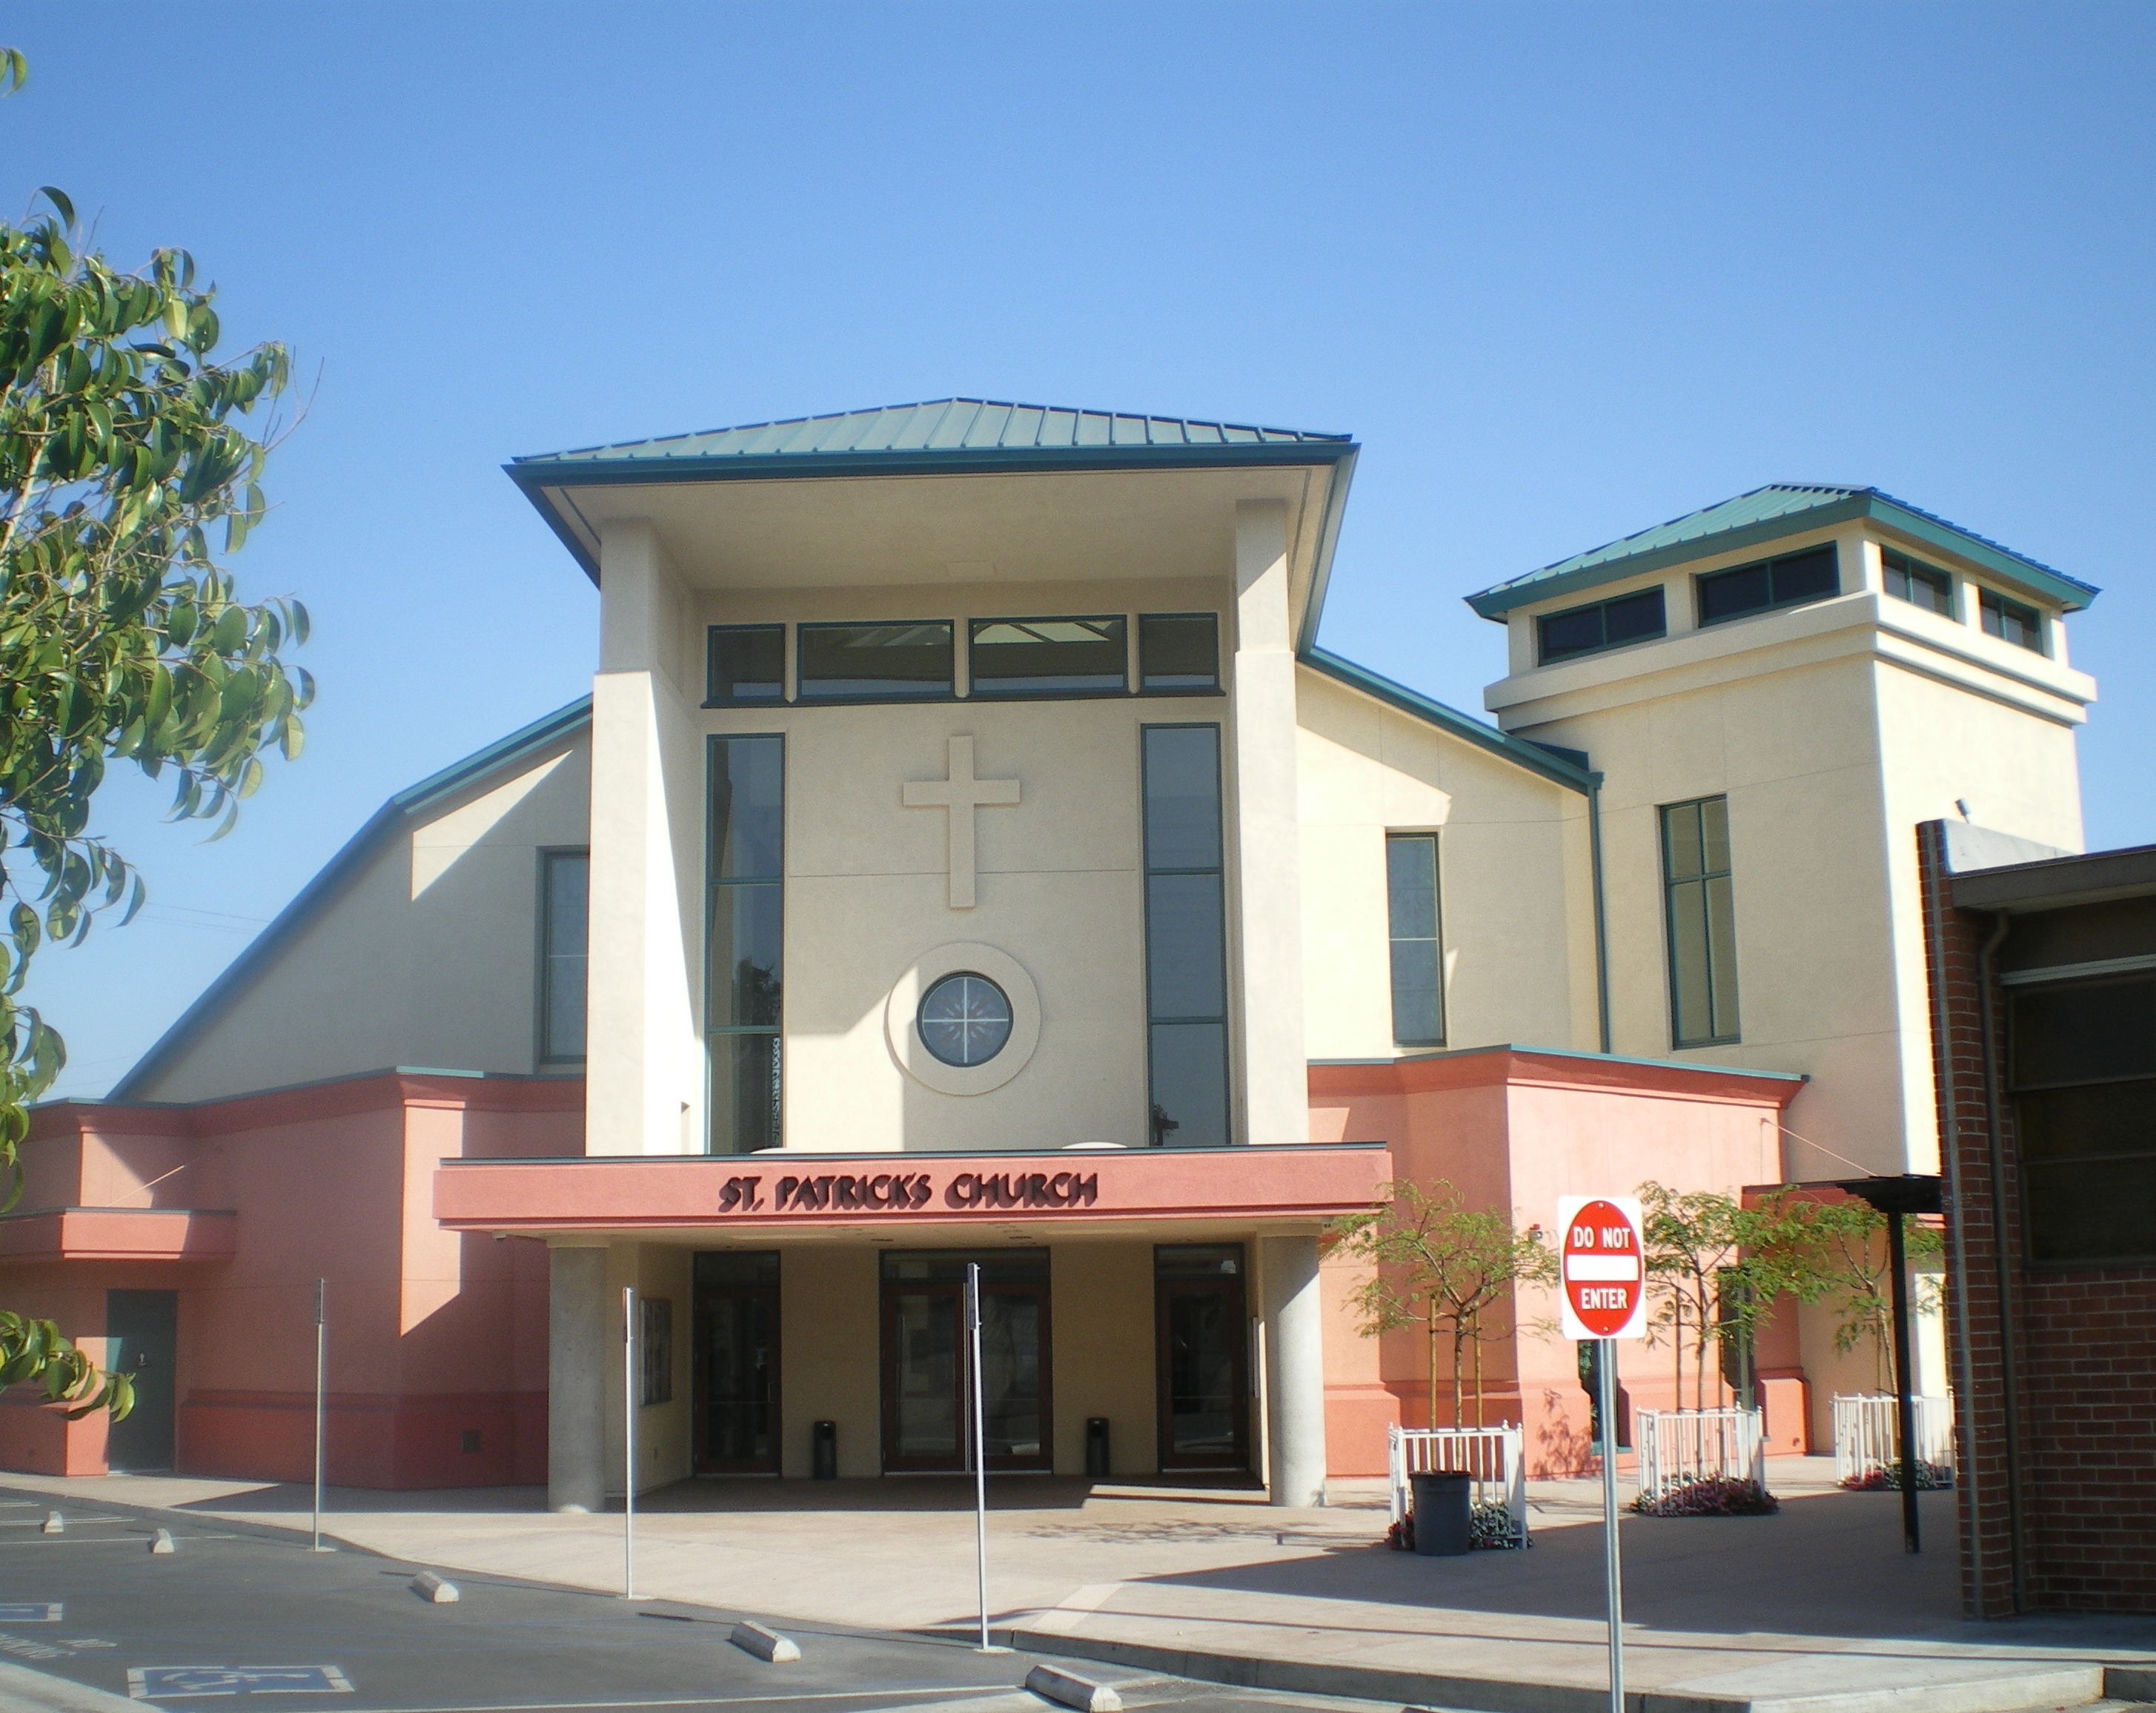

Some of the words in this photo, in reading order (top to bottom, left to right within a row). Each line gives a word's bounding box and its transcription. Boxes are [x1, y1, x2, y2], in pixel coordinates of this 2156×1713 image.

[718, 1176, 765, 1213] ST.
[775, 1172, 932, 1212] PATRICK'S
[944, 1172, 1098, 1210] CHURCH
[1573, 1226, 1594, 1248] DO
[1602, 1227, 1631, 1249] NOT
[1581, 1288, 1628, 1310] ENTER
